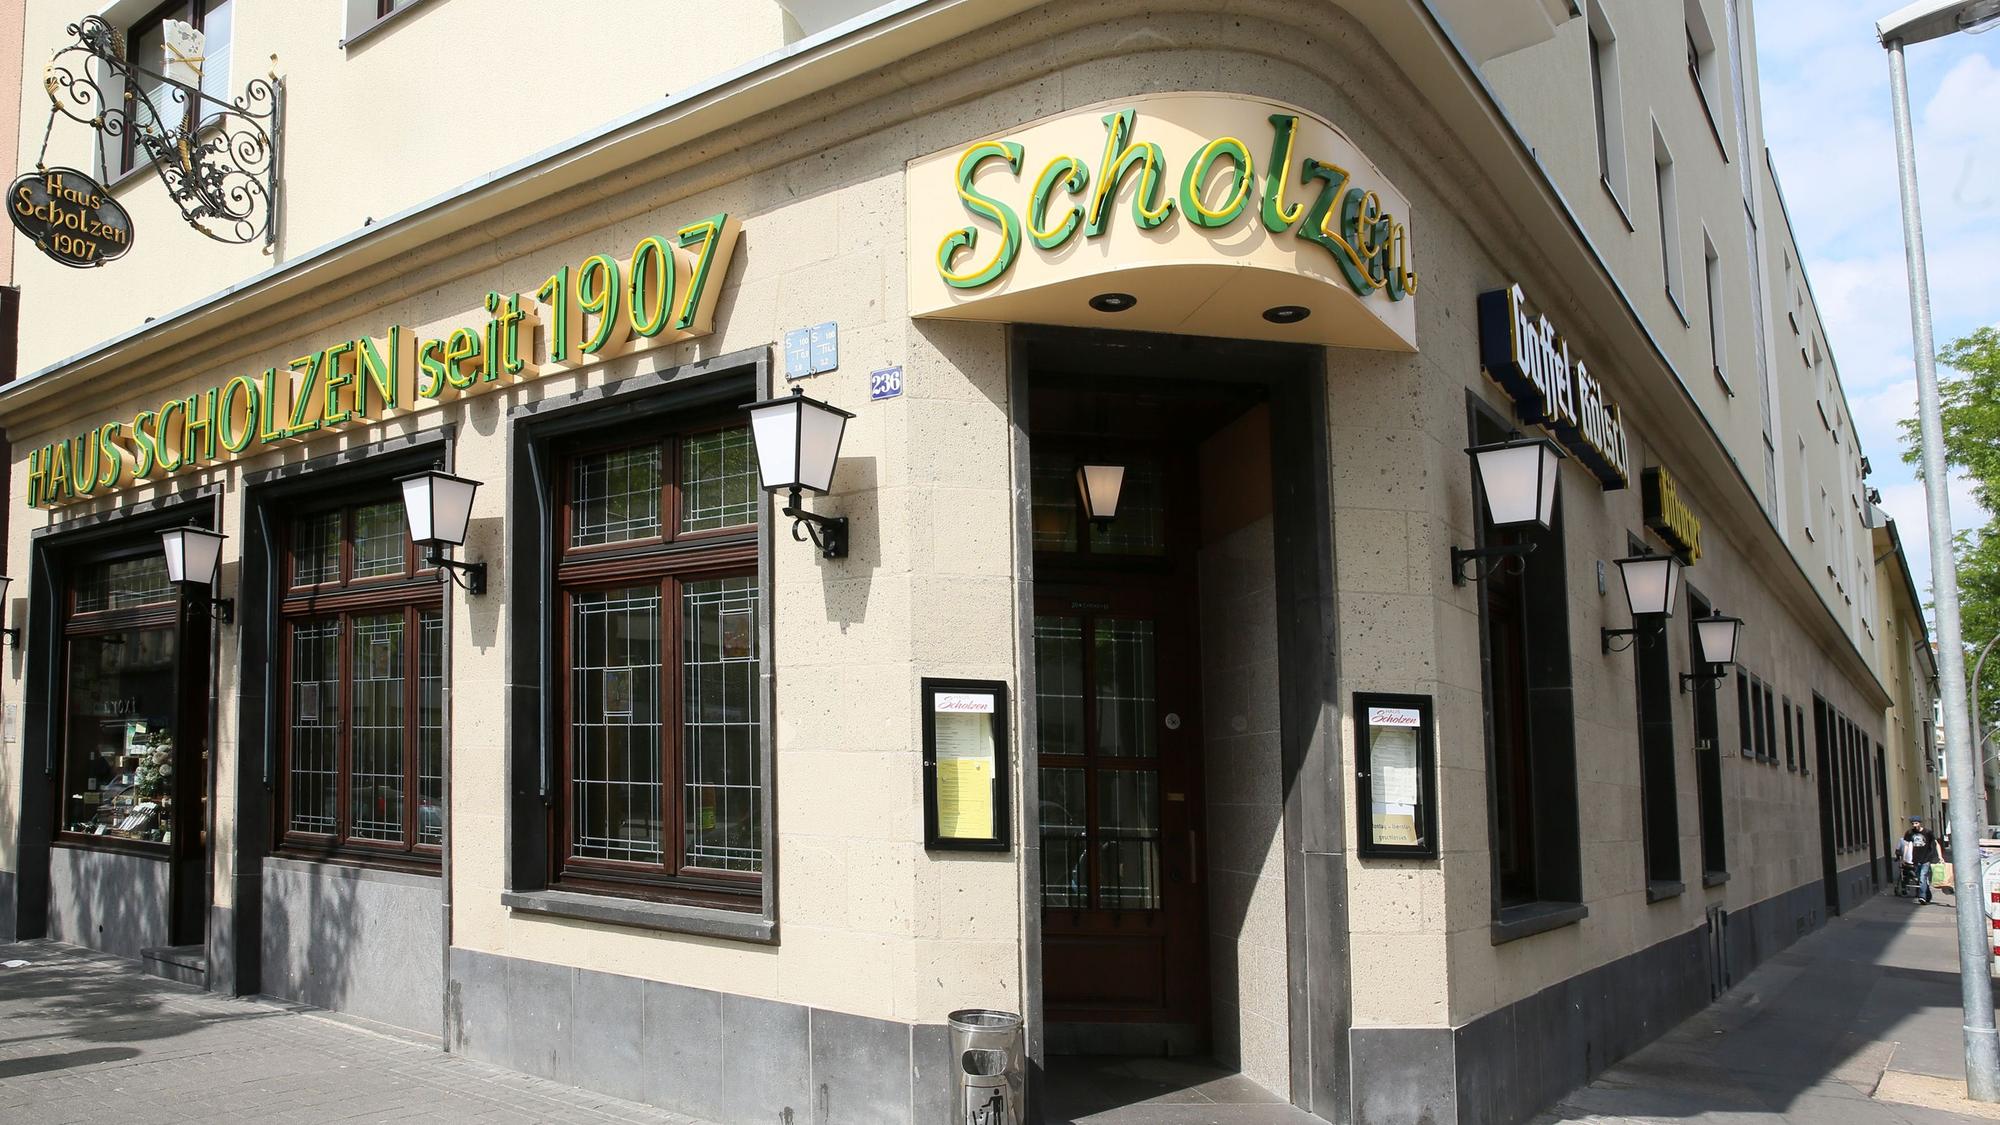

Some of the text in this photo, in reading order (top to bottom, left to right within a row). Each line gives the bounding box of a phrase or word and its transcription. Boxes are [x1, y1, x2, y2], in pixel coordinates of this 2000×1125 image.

[47, 174, 100, 209] Haus
[936, 108, 1418, 301] Scholzen
[16, 187, 126, 244] Scholzen
[51, 233, 97, 260] 1907
[27, 212, 728, 508] HAUS SCHOLZEN seit 1907
[872, 371, 900, 395] 236
[1511, 282, 1631, 490] Gaffel Kölsch
[1371, 710, 1417, 724] Scholzen
